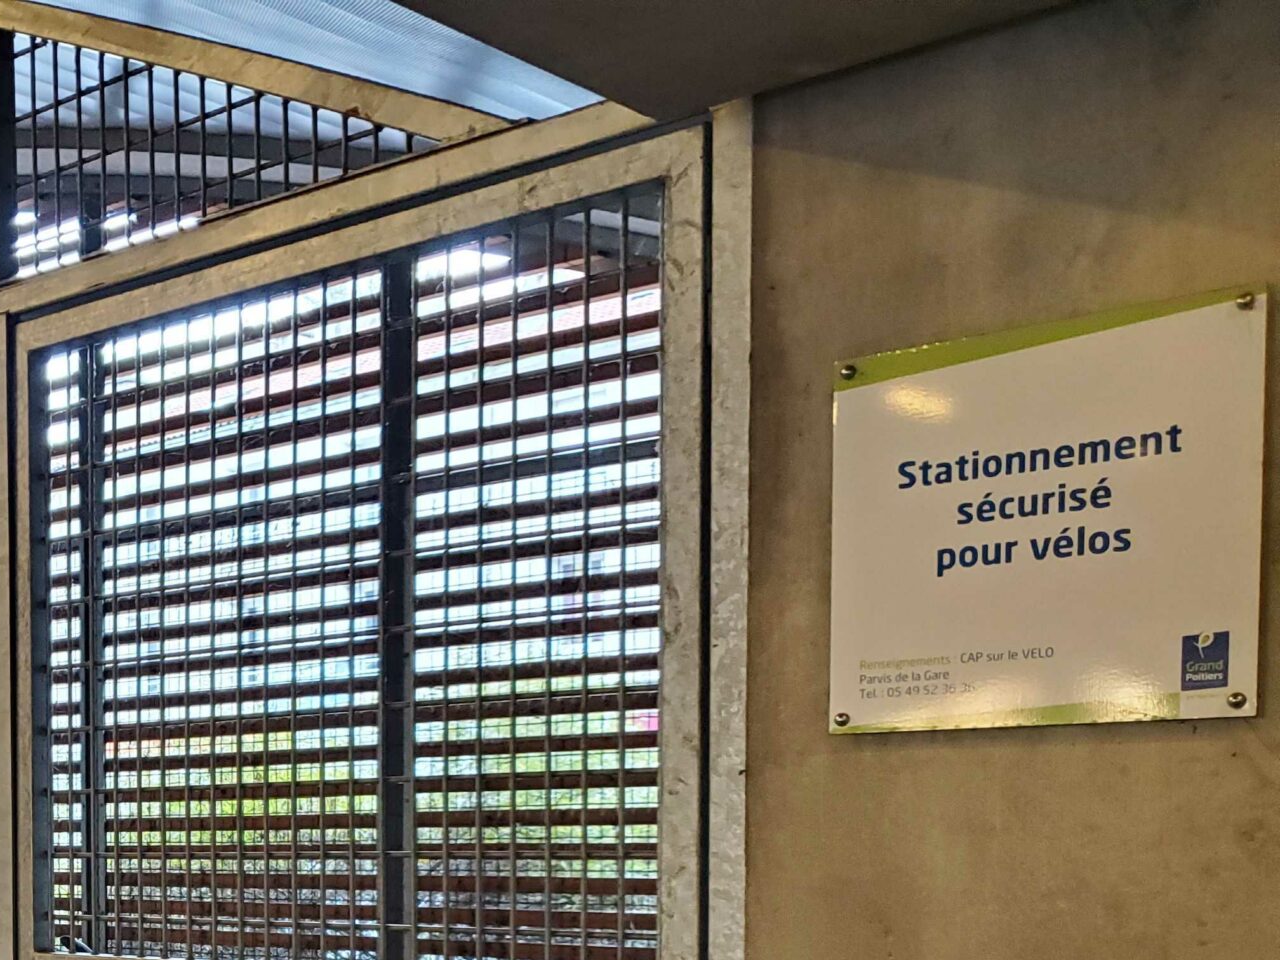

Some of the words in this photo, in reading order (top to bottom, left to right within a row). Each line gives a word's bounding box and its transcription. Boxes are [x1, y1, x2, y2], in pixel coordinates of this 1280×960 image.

[897, 424, 1183, 489] Stationnement
[956, 477, 1113, 525] sécurisé
[936, 537, 1019, 577] pour
[1030, 526, 1132, 561] vélos
[960, 652, 984, 664] CAP
[986, 652, 1005, 662] sur
[1007, 650, 1019, 660] le
[1022, 646, 1055, 659] VELO
[1186, 660, 1224, 673] Grand
[859, 672, 893, 685] Parvis
[894, 672, 909, 683] de
[911, 670, 921, 681] la
[923, 669, 950, 681] Gare
[1185, 672, 1224, 682] Poitiers
[886, 686, 902, 698] 05
[904, 685, 920, 696] 49
[923, 684, 938, 695] 52
[942, 683, 956, 694] 36
